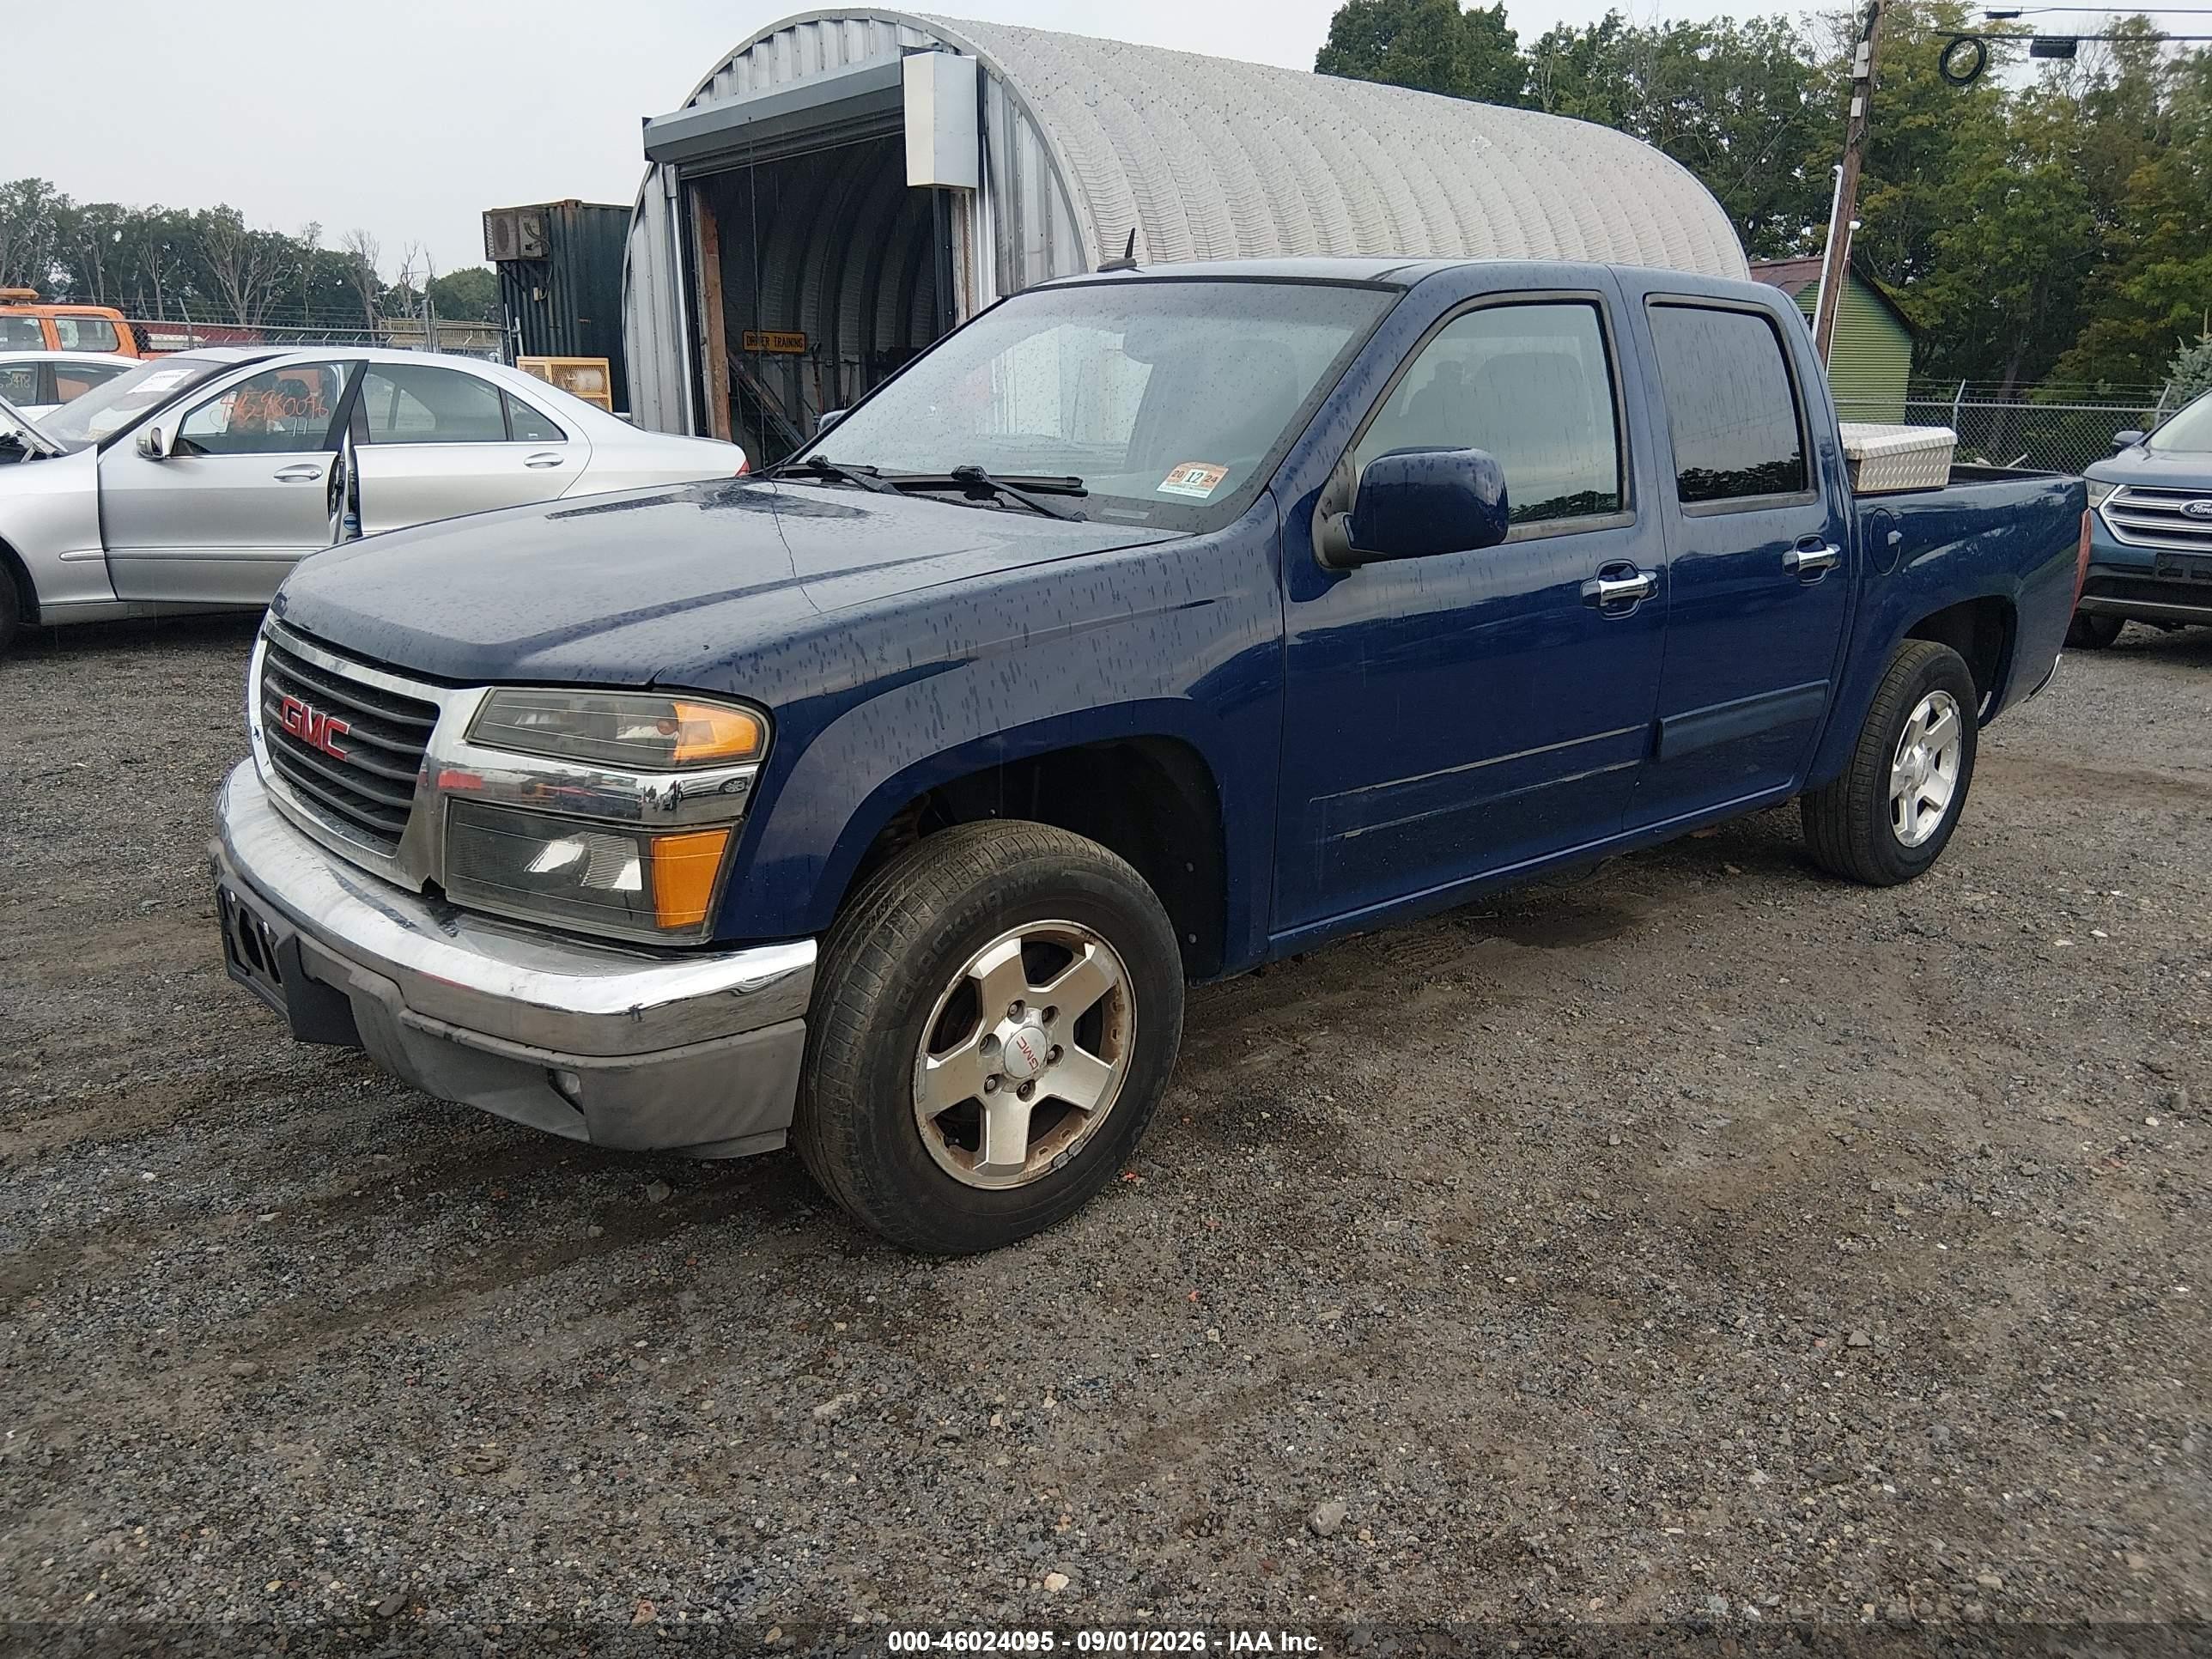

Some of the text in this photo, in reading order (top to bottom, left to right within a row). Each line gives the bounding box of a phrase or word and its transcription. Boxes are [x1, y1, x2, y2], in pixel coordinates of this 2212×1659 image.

[774, 336, 803, 349] TRAINING
[1171, 470, 1185, 478] 20
[1185, 471, 1204, 483] 12
[282, 695, 350, 763] GMC
[1016, 1036, 1039, 1070] GMC
